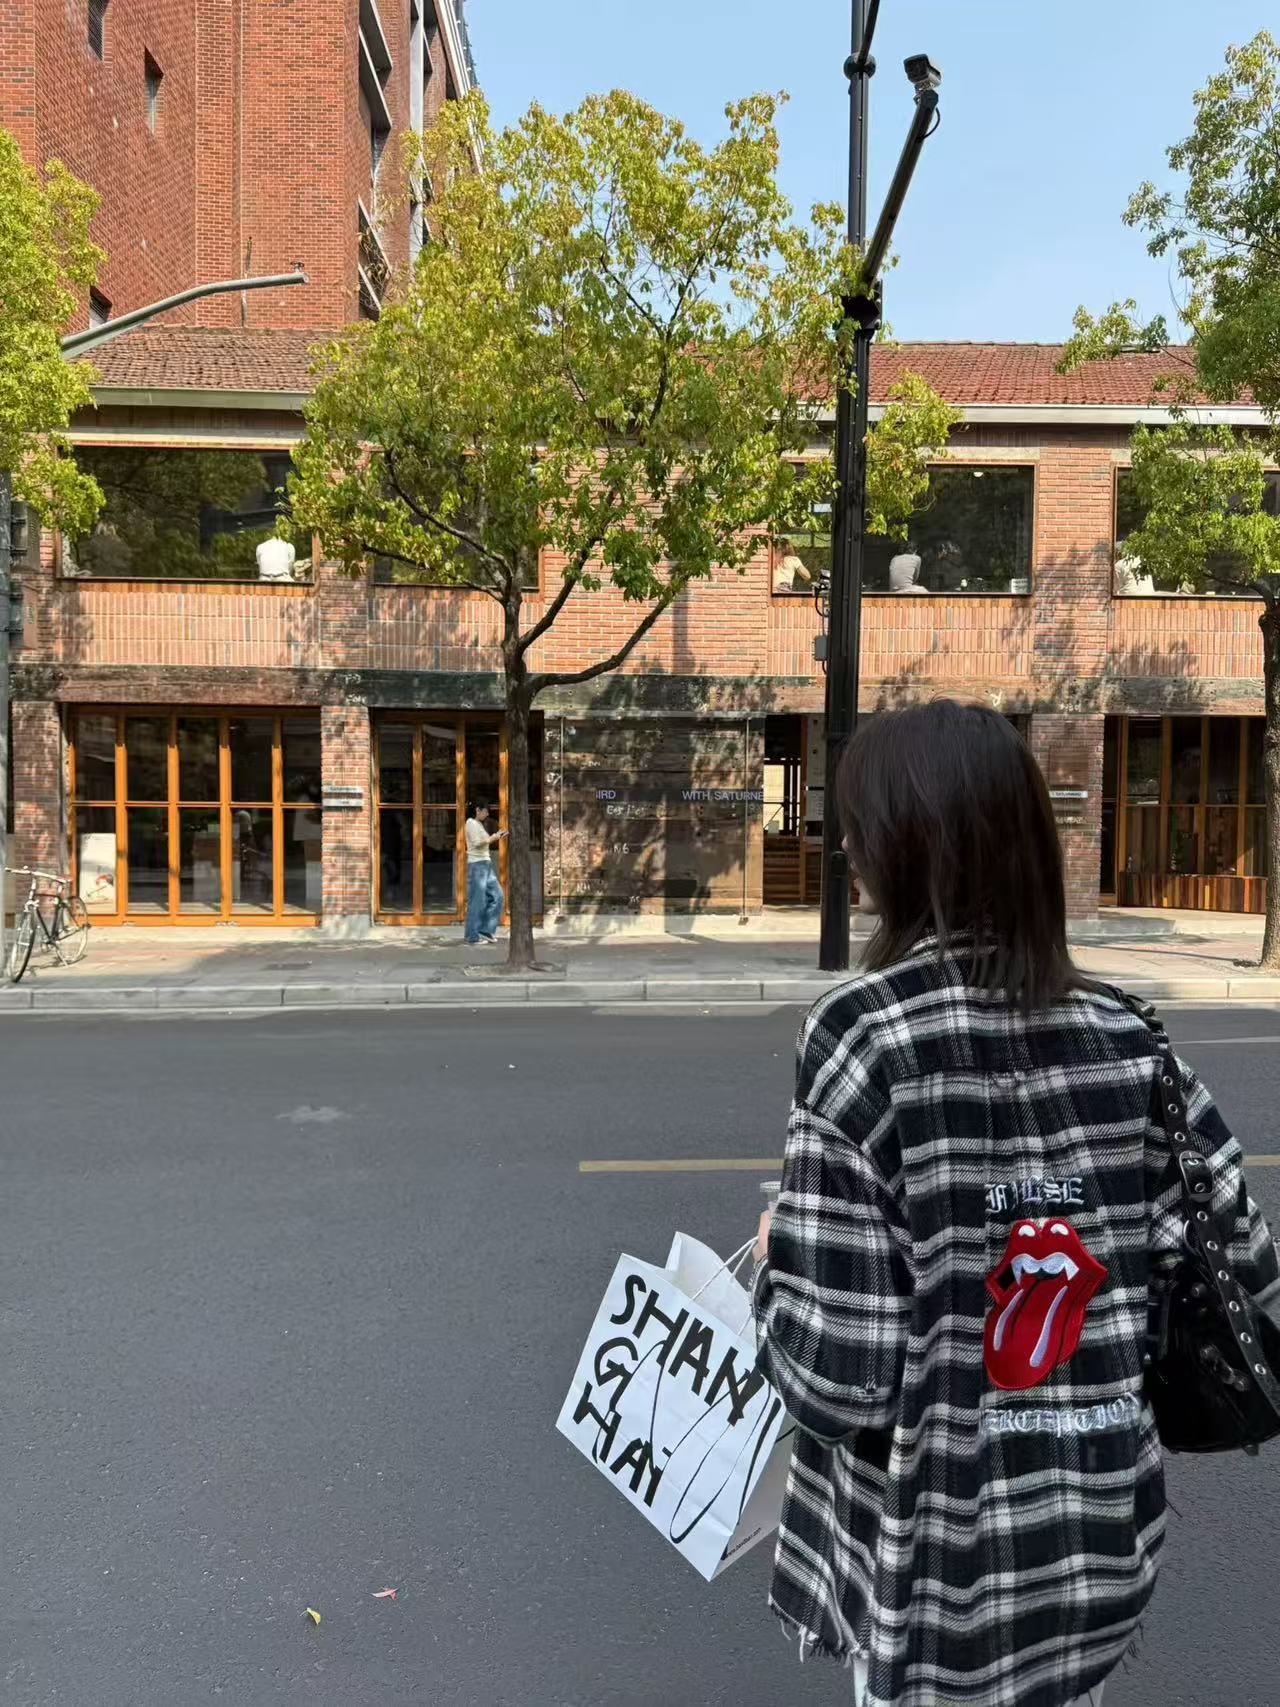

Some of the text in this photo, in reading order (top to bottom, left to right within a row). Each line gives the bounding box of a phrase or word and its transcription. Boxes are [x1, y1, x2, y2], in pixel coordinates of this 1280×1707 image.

[596, 790, 616, 799] IRD
[682, 790, 711, 800] WITH
[610, 1274, 766, 1427] SHAN
